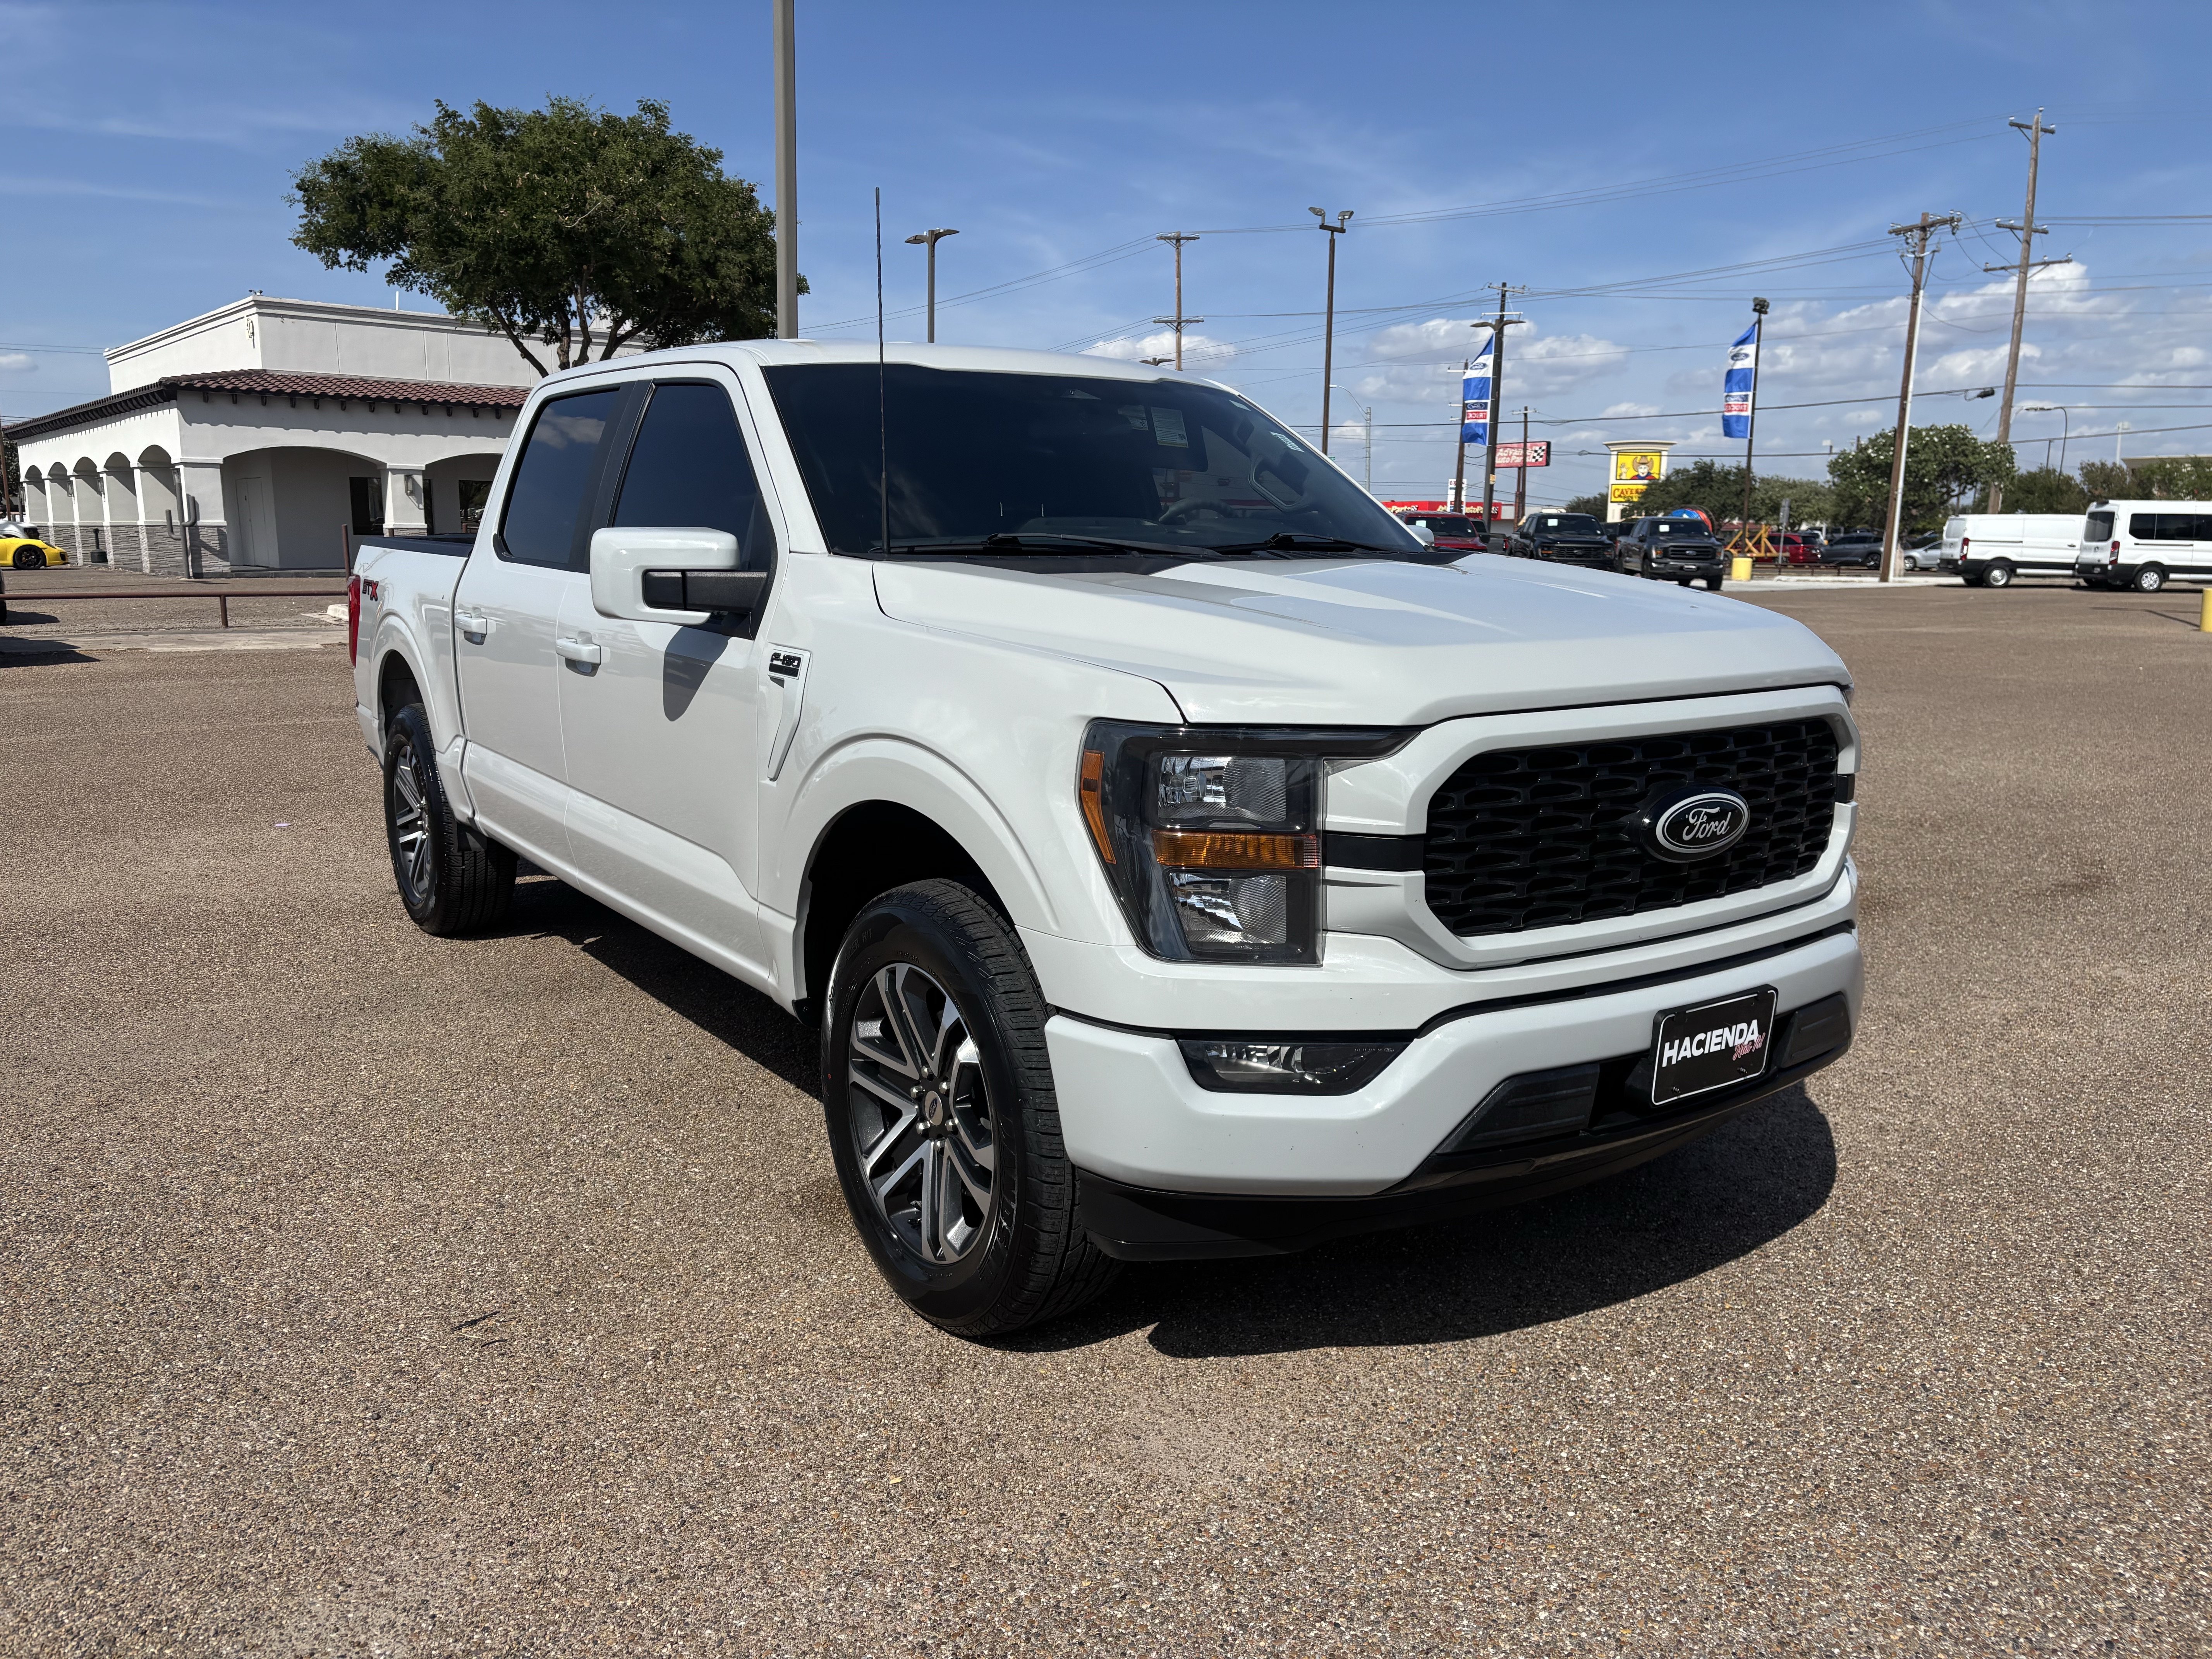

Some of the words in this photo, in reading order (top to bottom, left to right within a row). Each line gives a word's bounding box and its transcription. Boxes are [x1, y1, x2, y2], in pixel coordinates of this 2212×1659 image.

[1498, 447, 1534, 456] Advane
[1511, 455, 1532, 463] Pars
[1683, 807, 1731, 841] Ford
[1662, 1019, 1759, 1068] HACIENDA
